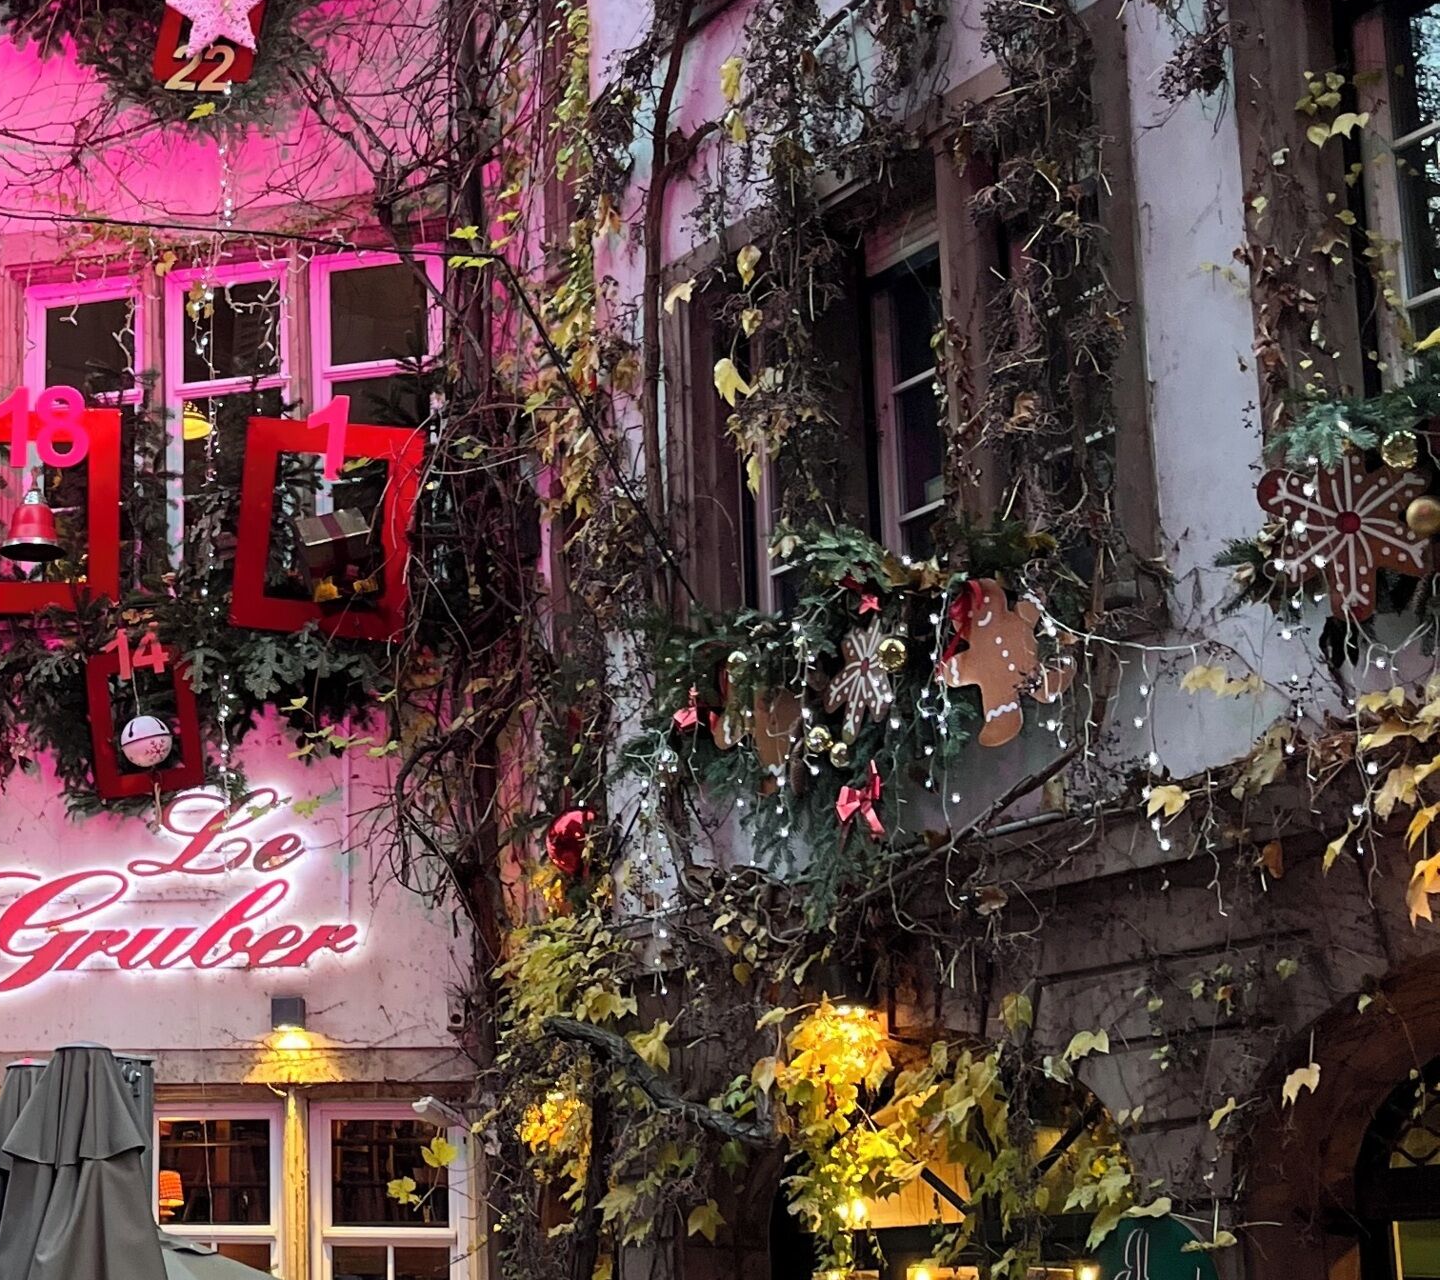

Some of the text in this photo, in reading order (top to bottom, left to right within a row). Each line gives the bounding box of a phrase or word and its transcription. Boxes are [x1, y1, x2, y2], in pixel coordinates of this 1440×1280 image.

[164, 45, 235, 92] 22
[307, 395, 350, 482] 1
[102, 628, 169, 681] 14
[127, 787, 306, 877] Le
